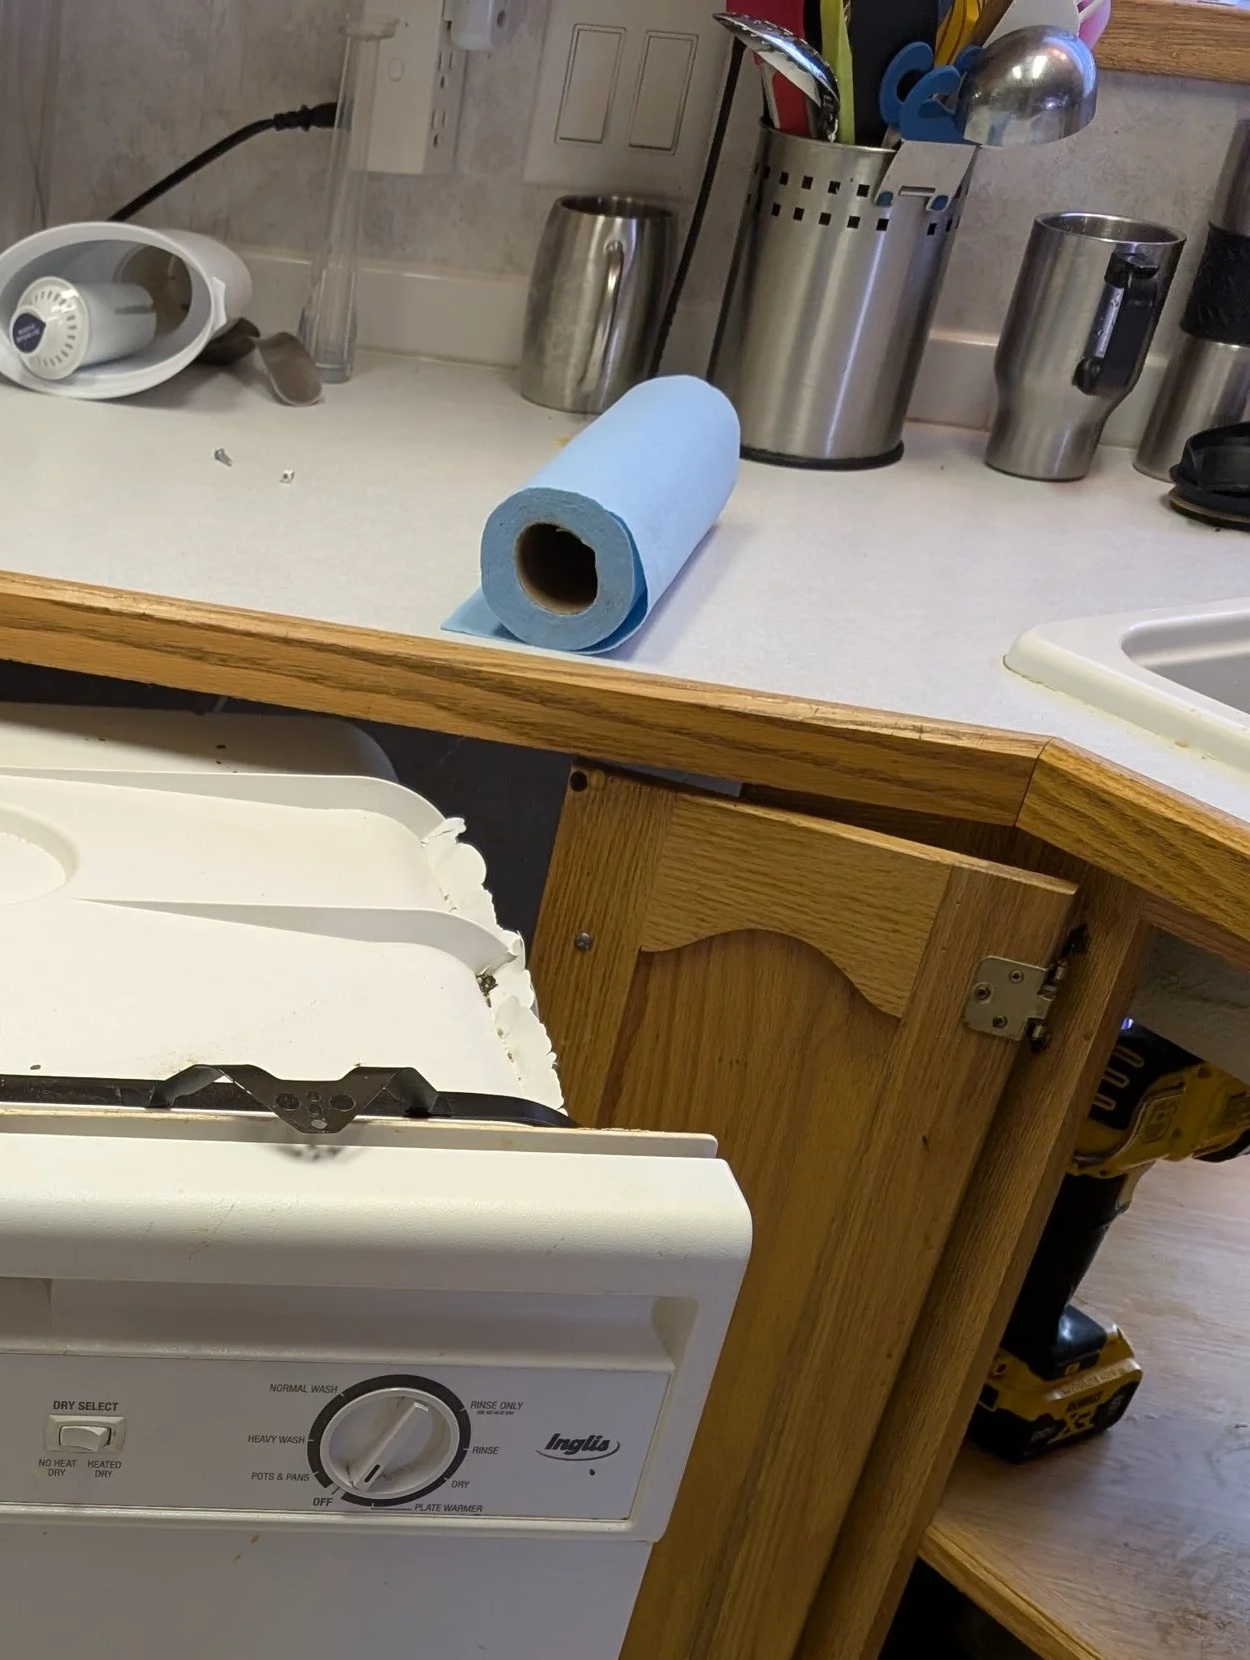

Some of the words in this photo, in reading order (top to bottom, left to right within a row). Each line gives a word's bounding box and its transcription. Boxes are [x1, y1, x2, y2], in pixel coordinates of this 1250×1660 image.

[269, 1383, 308, 1393] NORMAL
[310, 1385, 338, 1394] WASH
[53, 1400, 75, 1411] DRY
[77, 1401, 119, 1412] SELECT
[470, 1400, 498, 1410] RINSE
[500, 1401, 524, 1411] ONLY
[247, 1434, 277, 1444] HEAVY
[278, 1435, 306, 1445] WASH
[544, 1433, 611, 1456] Inglis
[472, 1446, 499, 1455] RINSE
[38, 1458, 52, 1468] NO
[54, 1459, 78, 1468] HEAT
[87, 1460, 122, 1470] HEATED
[47, 1468, 66, 1477] DRY
[94, 1469, 113, 1478] DRY
[251, 1471, 275, 1481] POTS
[276, 1472, 284, 1481] &
[286, 1473, 310, 1482] PANS
[451, 1480, 470, 1489] DRY
[312, 1497, 333, 1507] OFF
[414, 1503, 442, 1512] PLATE
[443, 1504, 483, 1514] WARMER
